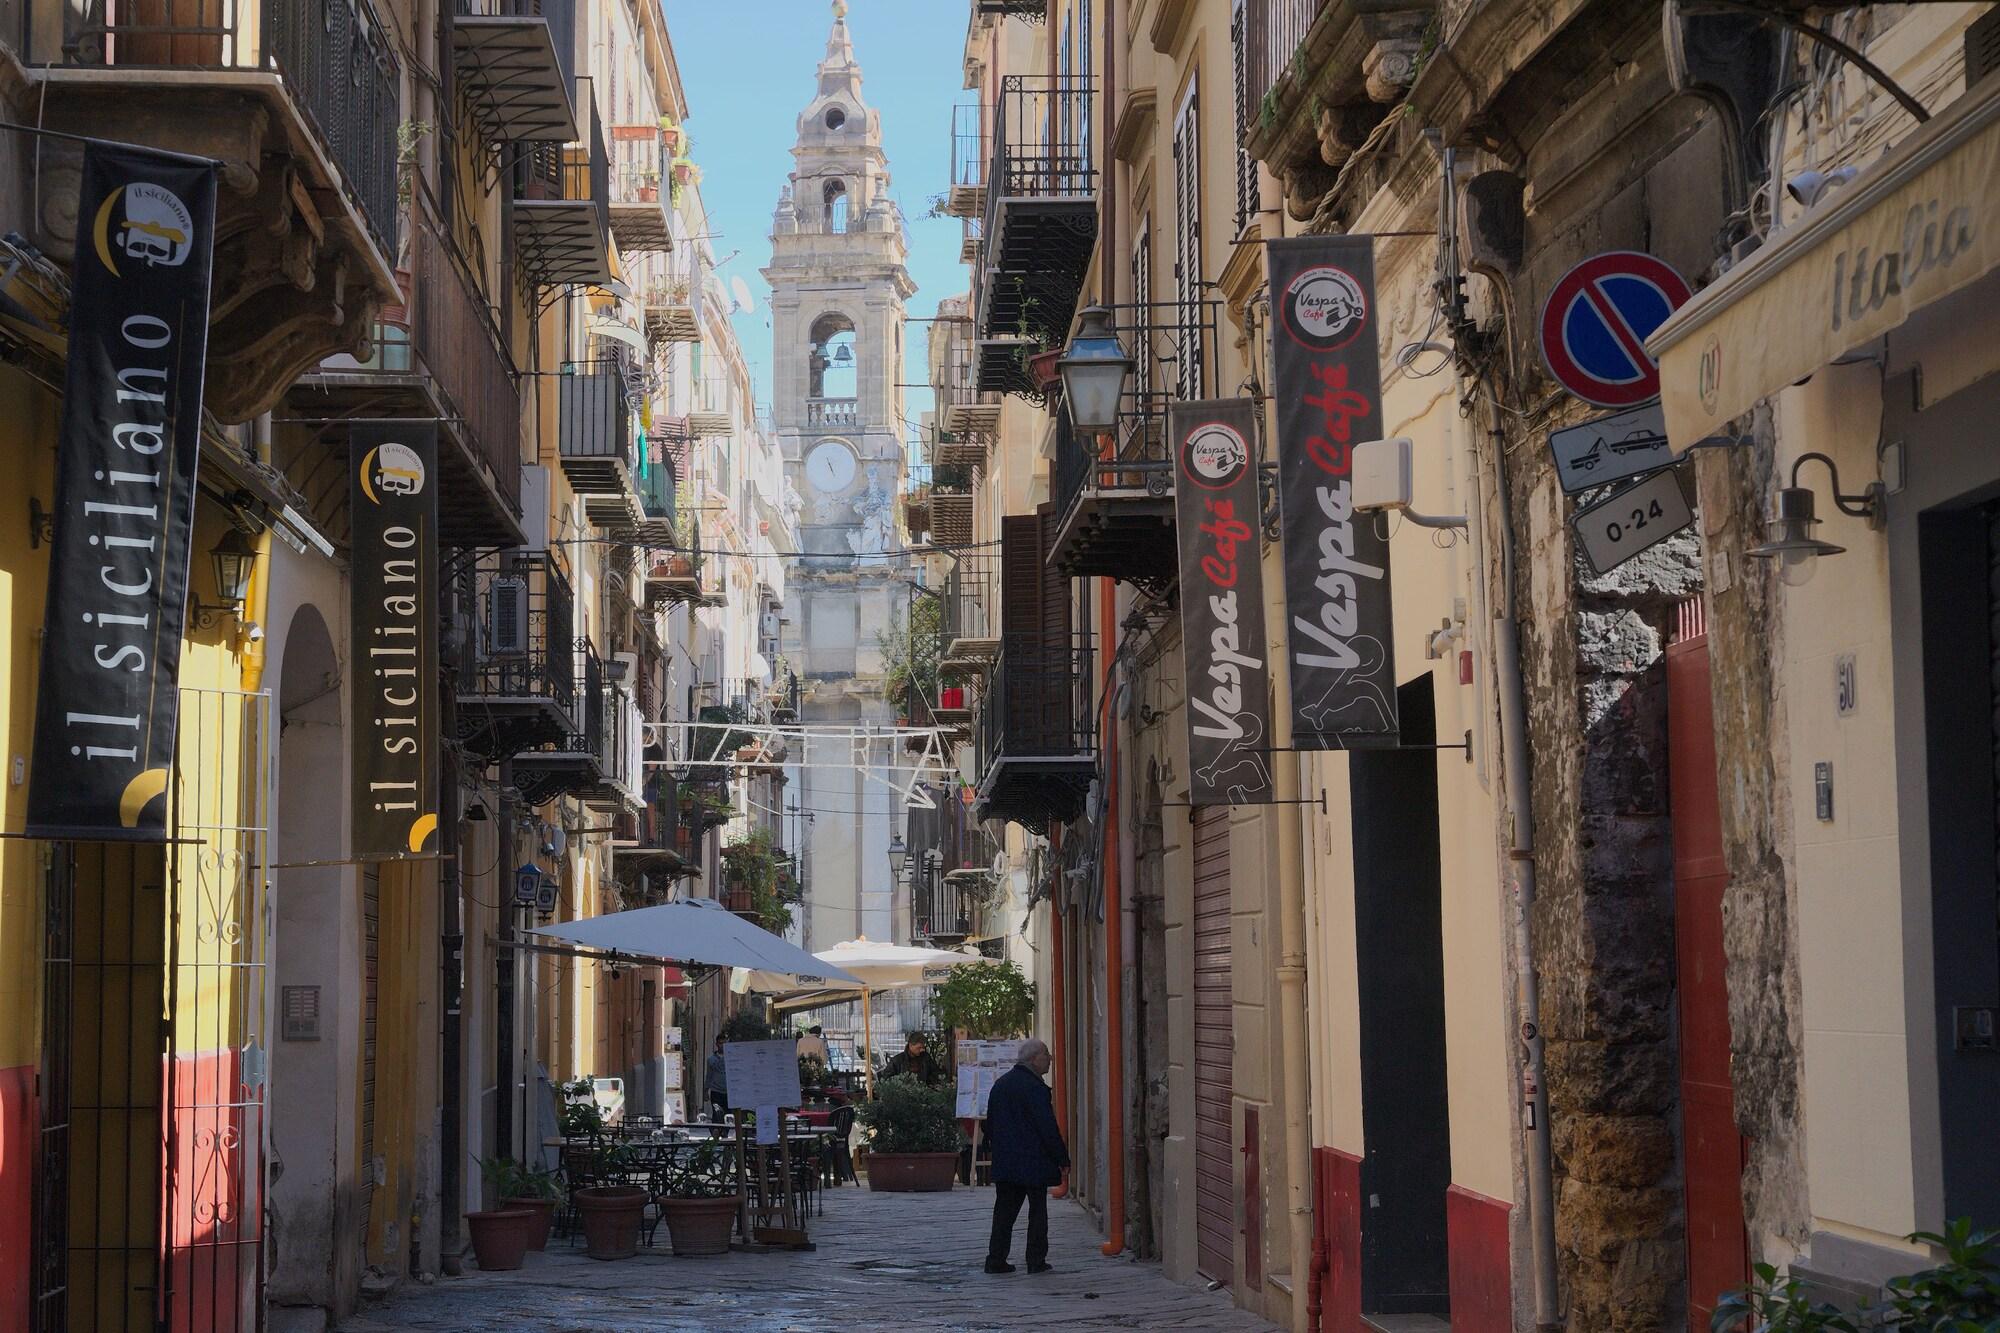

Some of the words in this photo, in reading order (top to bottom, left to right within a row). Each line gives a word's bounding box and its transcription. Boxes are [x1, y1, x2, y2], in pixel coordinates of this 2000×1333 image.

[134, 187, 142, 198] il
[1300, 294, 1339, 310] Vespa
[1832, 199, 1977, 332] Italia
[1196, 444, 1227, 457] Vespa
[1304, 362, 1372, 476] Café
[84, 314, 172, 673] siciliano
[1606, 499, 1664, 543] 0-24
[1200, 499, 1253, 588] Café
[1294, 480, 1385, 669] Vespa
[370, 525, 417, 755] siciliano
[1191, 590, 1263, 740] Vespa
[66, 711, 141, 764] il
[370, 780, 417, 812] il
